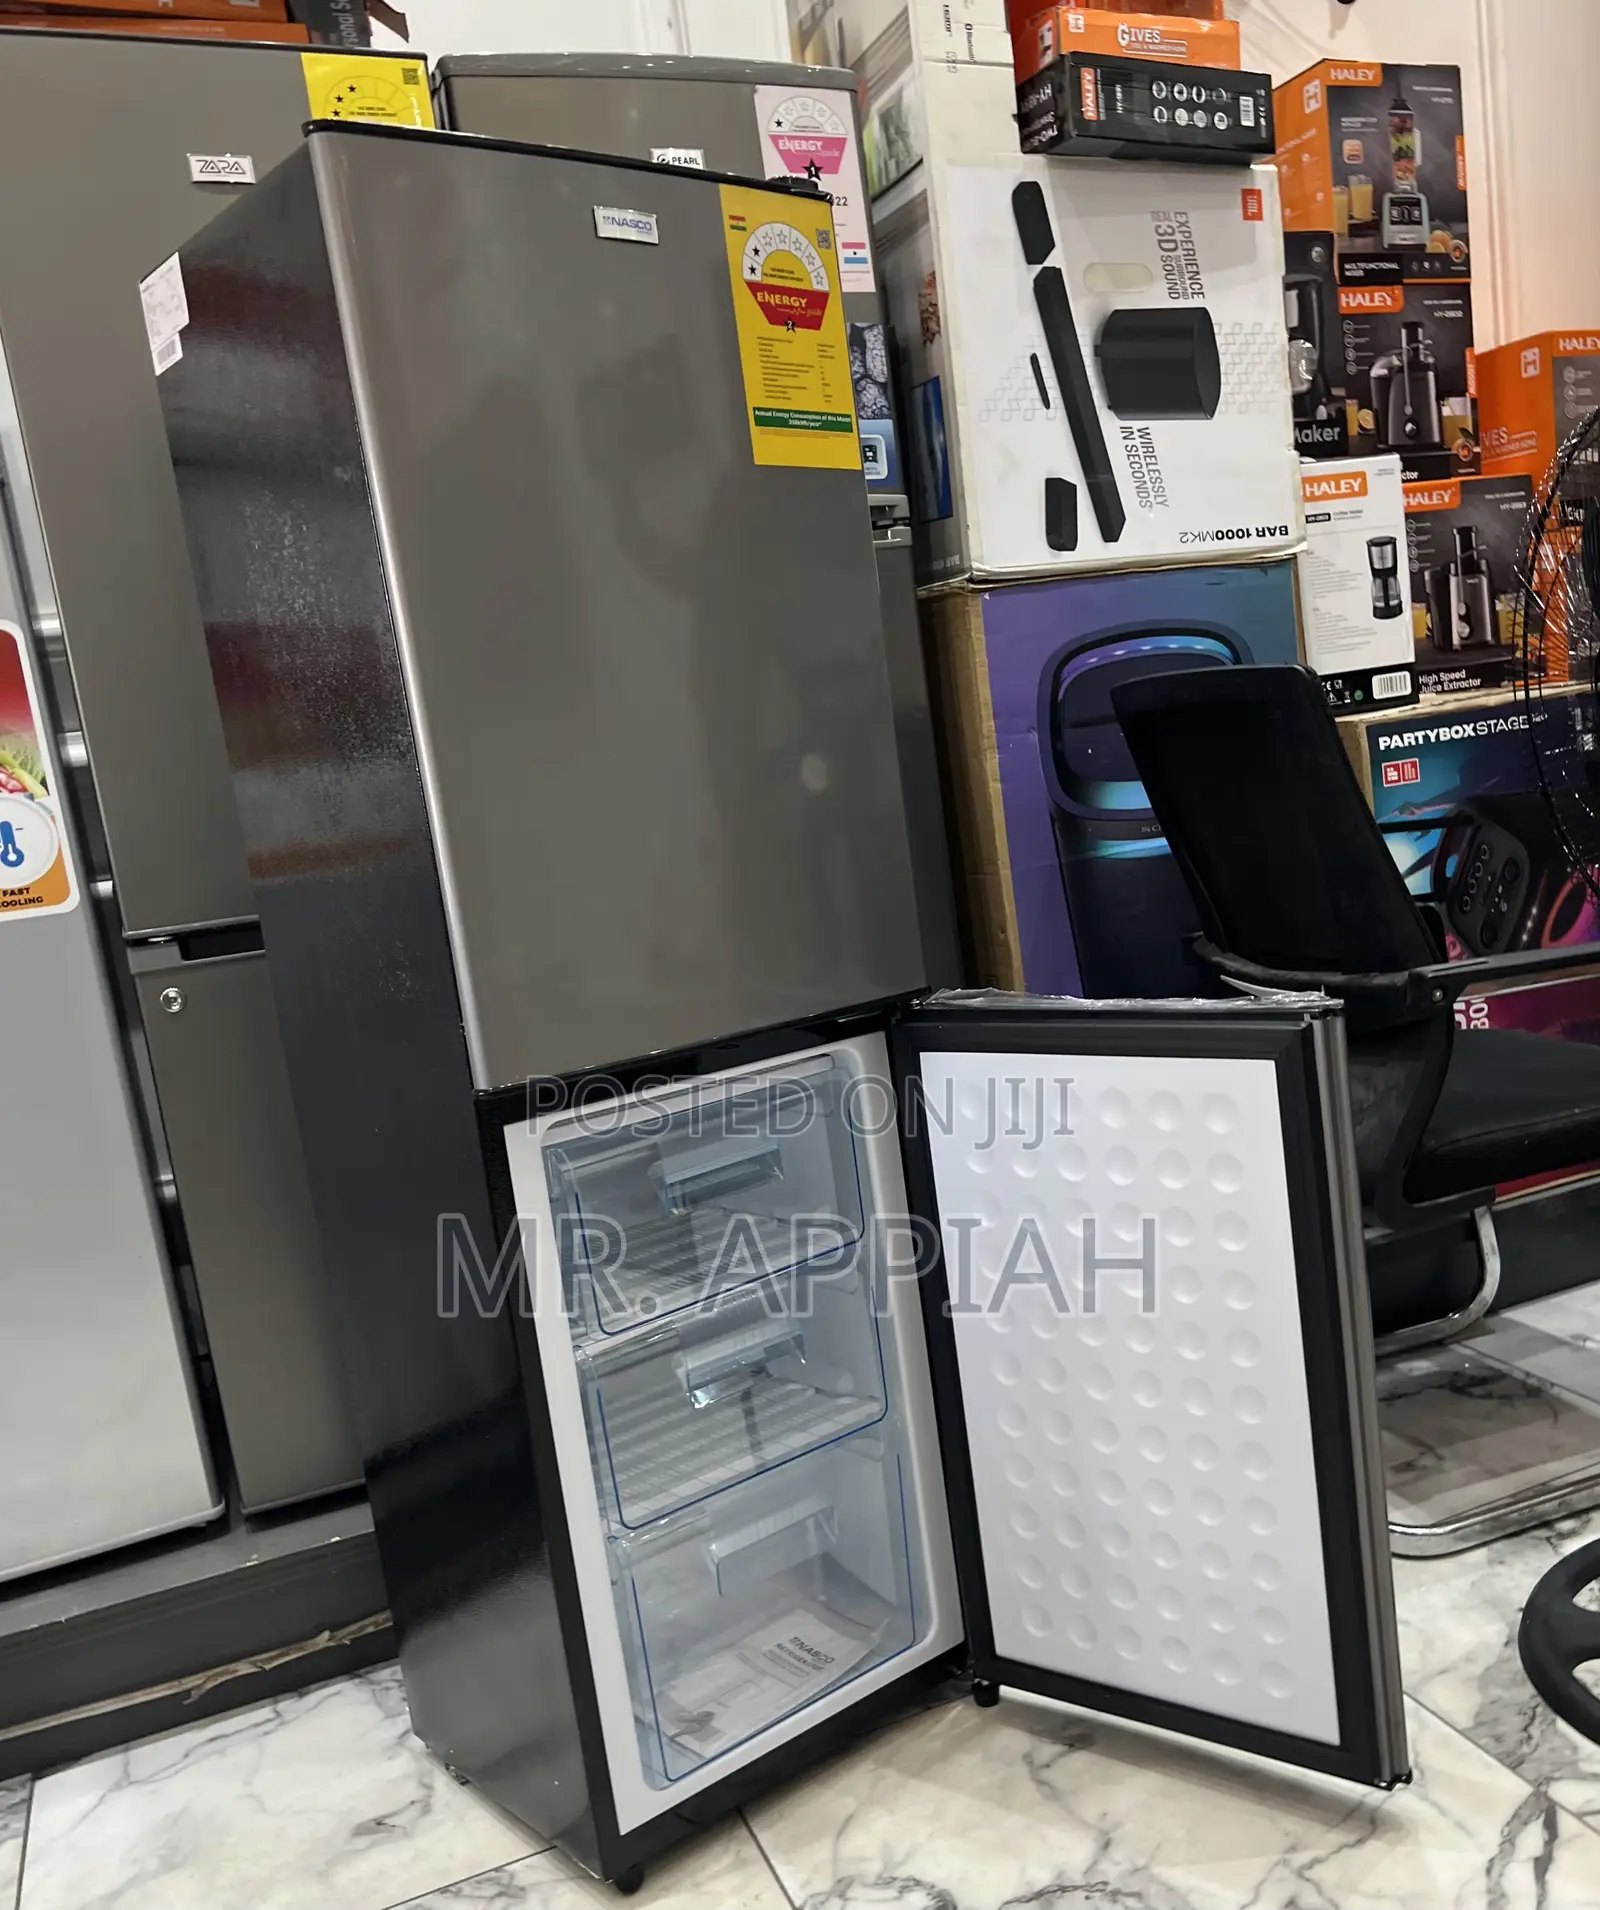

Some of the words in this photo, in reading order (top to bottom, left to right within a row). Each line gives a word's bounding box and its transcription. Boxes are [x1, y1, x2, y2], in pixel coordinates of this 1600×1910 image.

[1117, 22, 1161, 47] GIVES
[1330, 68, 1376, 81] HALEY
[778, 136, 823, 153] ENERGY
[195, 160, 246, 174] ZARA
[671, 155, 701, 166] PEARL
[810, 166, 816, 175] 1
[611, 216, 653, 231] NASCO
[1154, 224, 1179, 253] 3D
[1174, 211, 1206, 300] EXPERIENCE
[1160, 254, 1181, 300] SOUND
[756, 290, 808, 308] ENERGY
[1340, 291, 1394, 308] HALEY
[786, 321, 794, 330] 2
[1119, 426, 1136, 440] IN
[1136, 427, 1170, 508] WIRELESSLY
[1125, 444, 1153, 510] SECONDS
[1304, 478, 1362, 497] HALEY
[1178, 528, 1253, 544] 1000MK2
[1255, 525, 1289, 538] BAR
[1418, 673, 1439, 686] High
[1439, 669, 1466, 683] Speed
[1420, 684, 1443, 694] Juice
[1443, 678, 1482, 691] Extractor
[2, 887, 31, 897] FAST
[0, 896, 44, 908] OOLING
